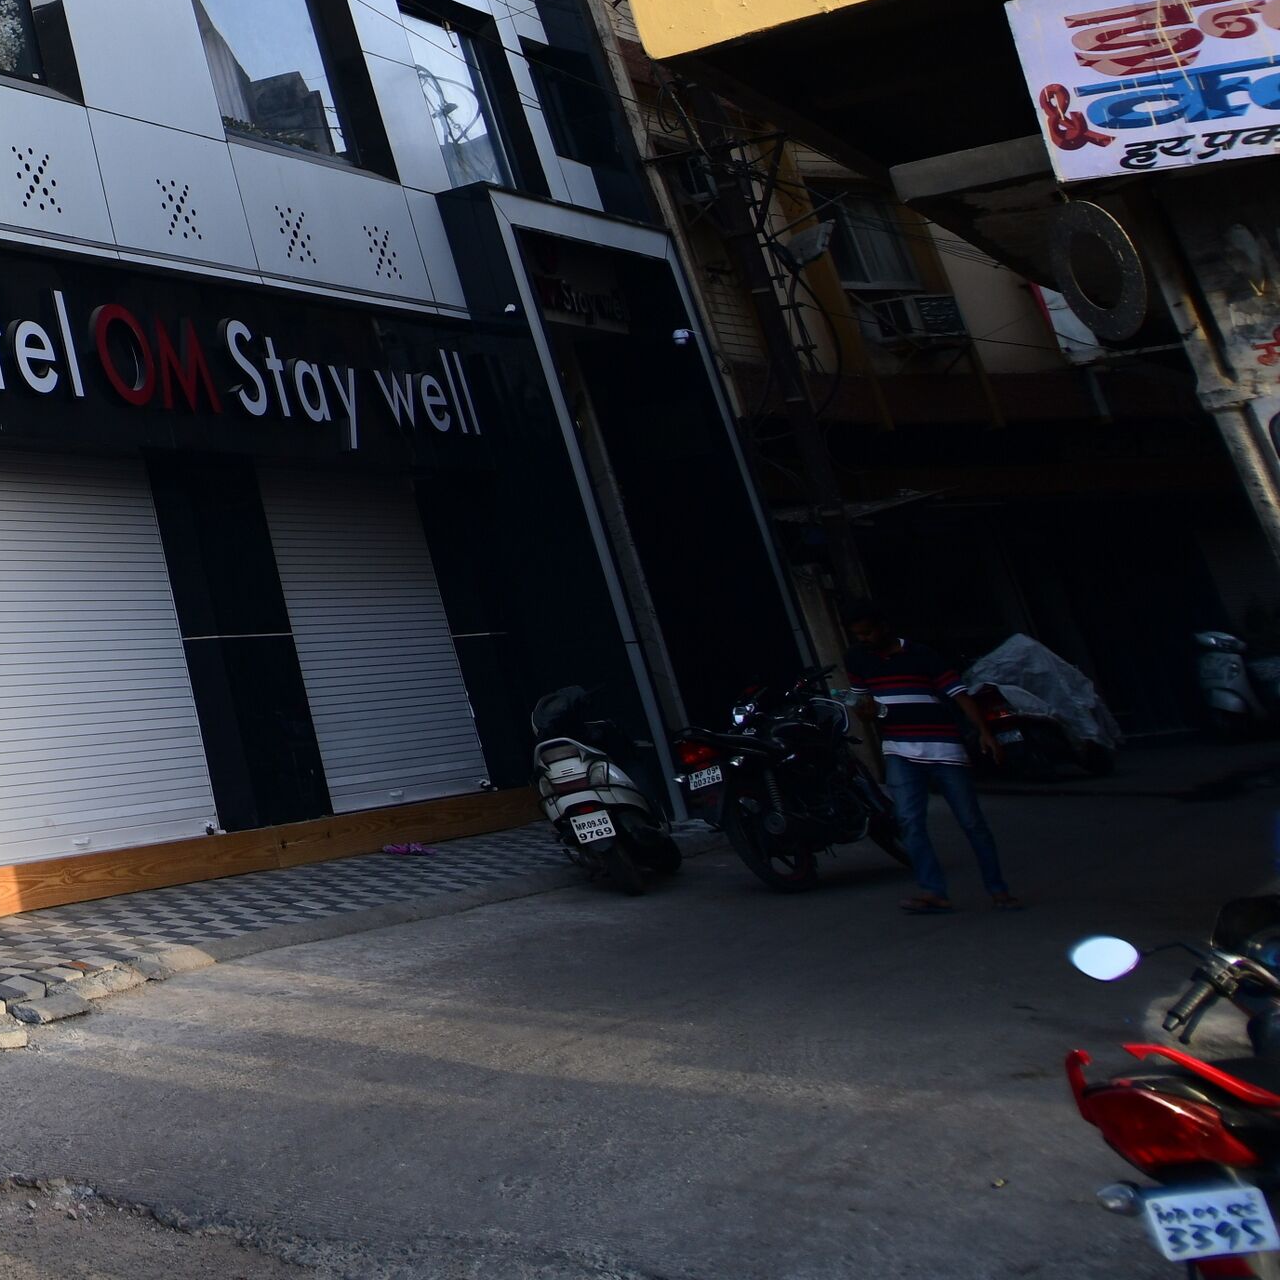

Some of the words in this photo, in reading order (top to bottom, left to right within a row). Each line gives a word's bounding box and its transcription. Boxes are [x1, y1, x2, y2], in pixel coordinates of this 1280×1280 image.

[1040, 84, 1116, 151] &
[1119, 134, 1193, 170] हर
[90, 302, 223, 415] OM
[218, 318, 359, 451] Stay
[371, 347, 482, 437] well
[579, 826, 613, 841] 9769
[1164, 1218, 1266, 1253] 3395
